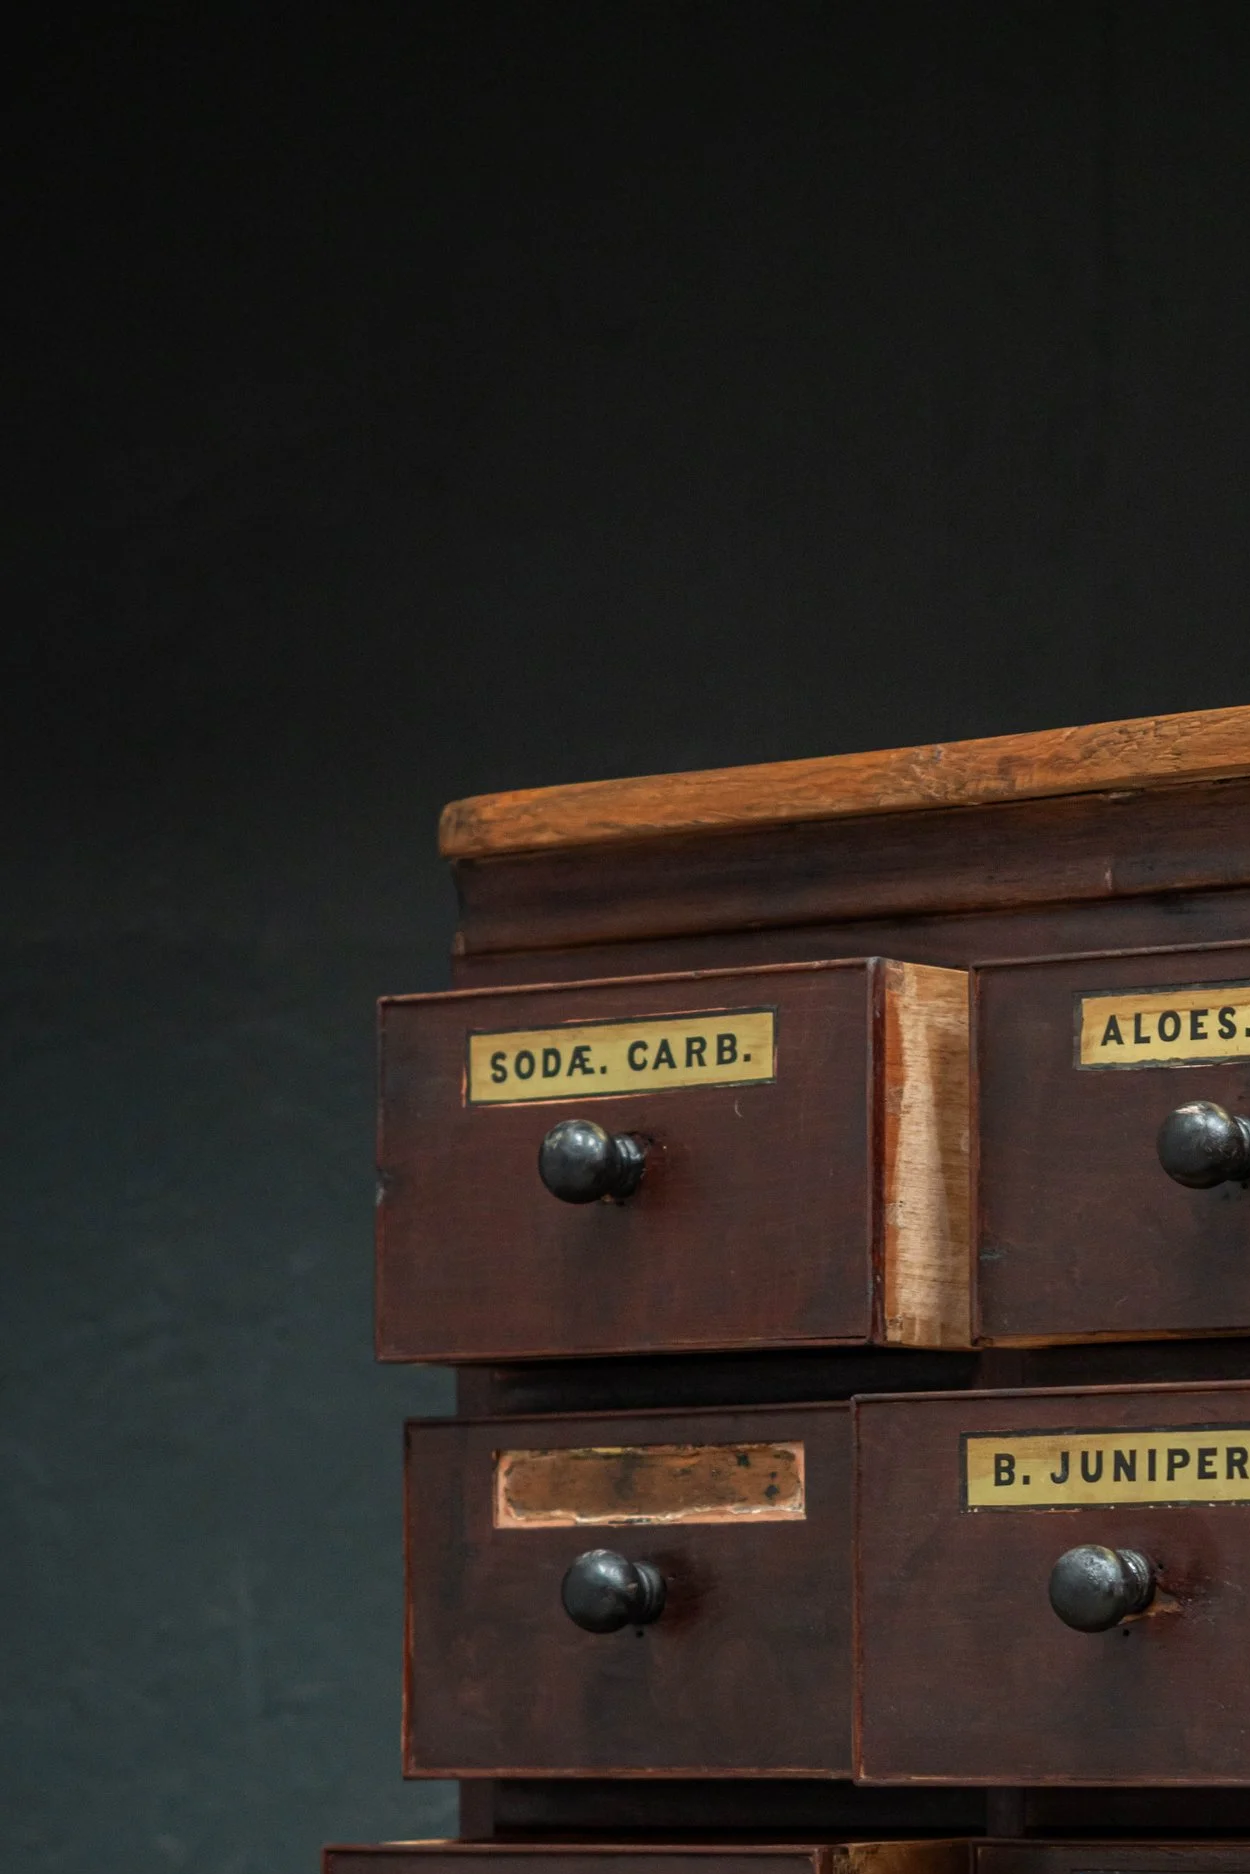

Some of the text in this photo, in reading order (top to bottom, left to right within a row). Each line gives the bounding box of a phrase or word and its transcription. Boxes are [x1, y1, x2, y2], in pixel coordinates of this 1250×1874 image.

[490, 1033, 752, 1084] SODÆ. CARB.
[993, 1453, 1031, 1487] B.
